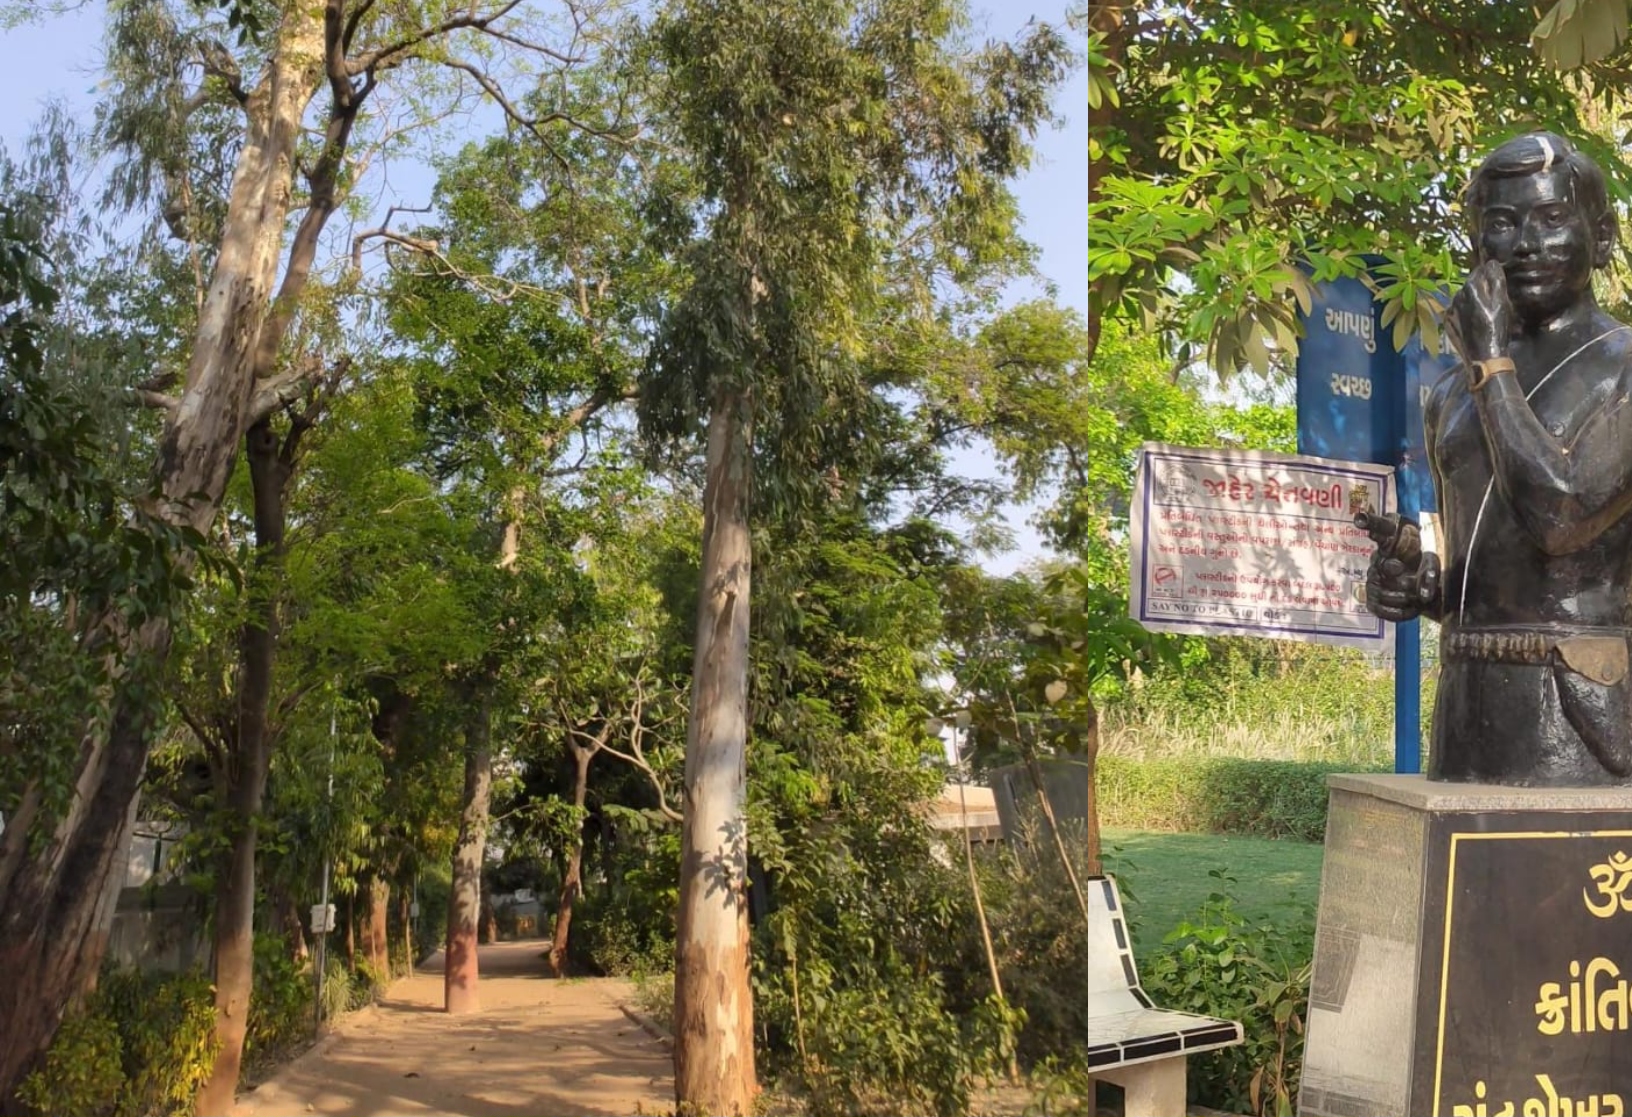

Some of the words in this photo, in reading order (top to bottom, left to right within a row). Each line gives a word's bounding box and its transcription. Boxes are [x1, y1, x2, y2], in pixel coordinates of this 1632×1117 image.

[1325, 307, 1377, 354] આપણું
[1330, 372, 1373, 400] સ્વચ્છ
[1203, 474, 1254, 501] જાહેર
[1263, 477, 1342, 508] ચેતવણી
[1151, 601, 1171, 611] SAY
[1173, 603, 1188, 612] NO
